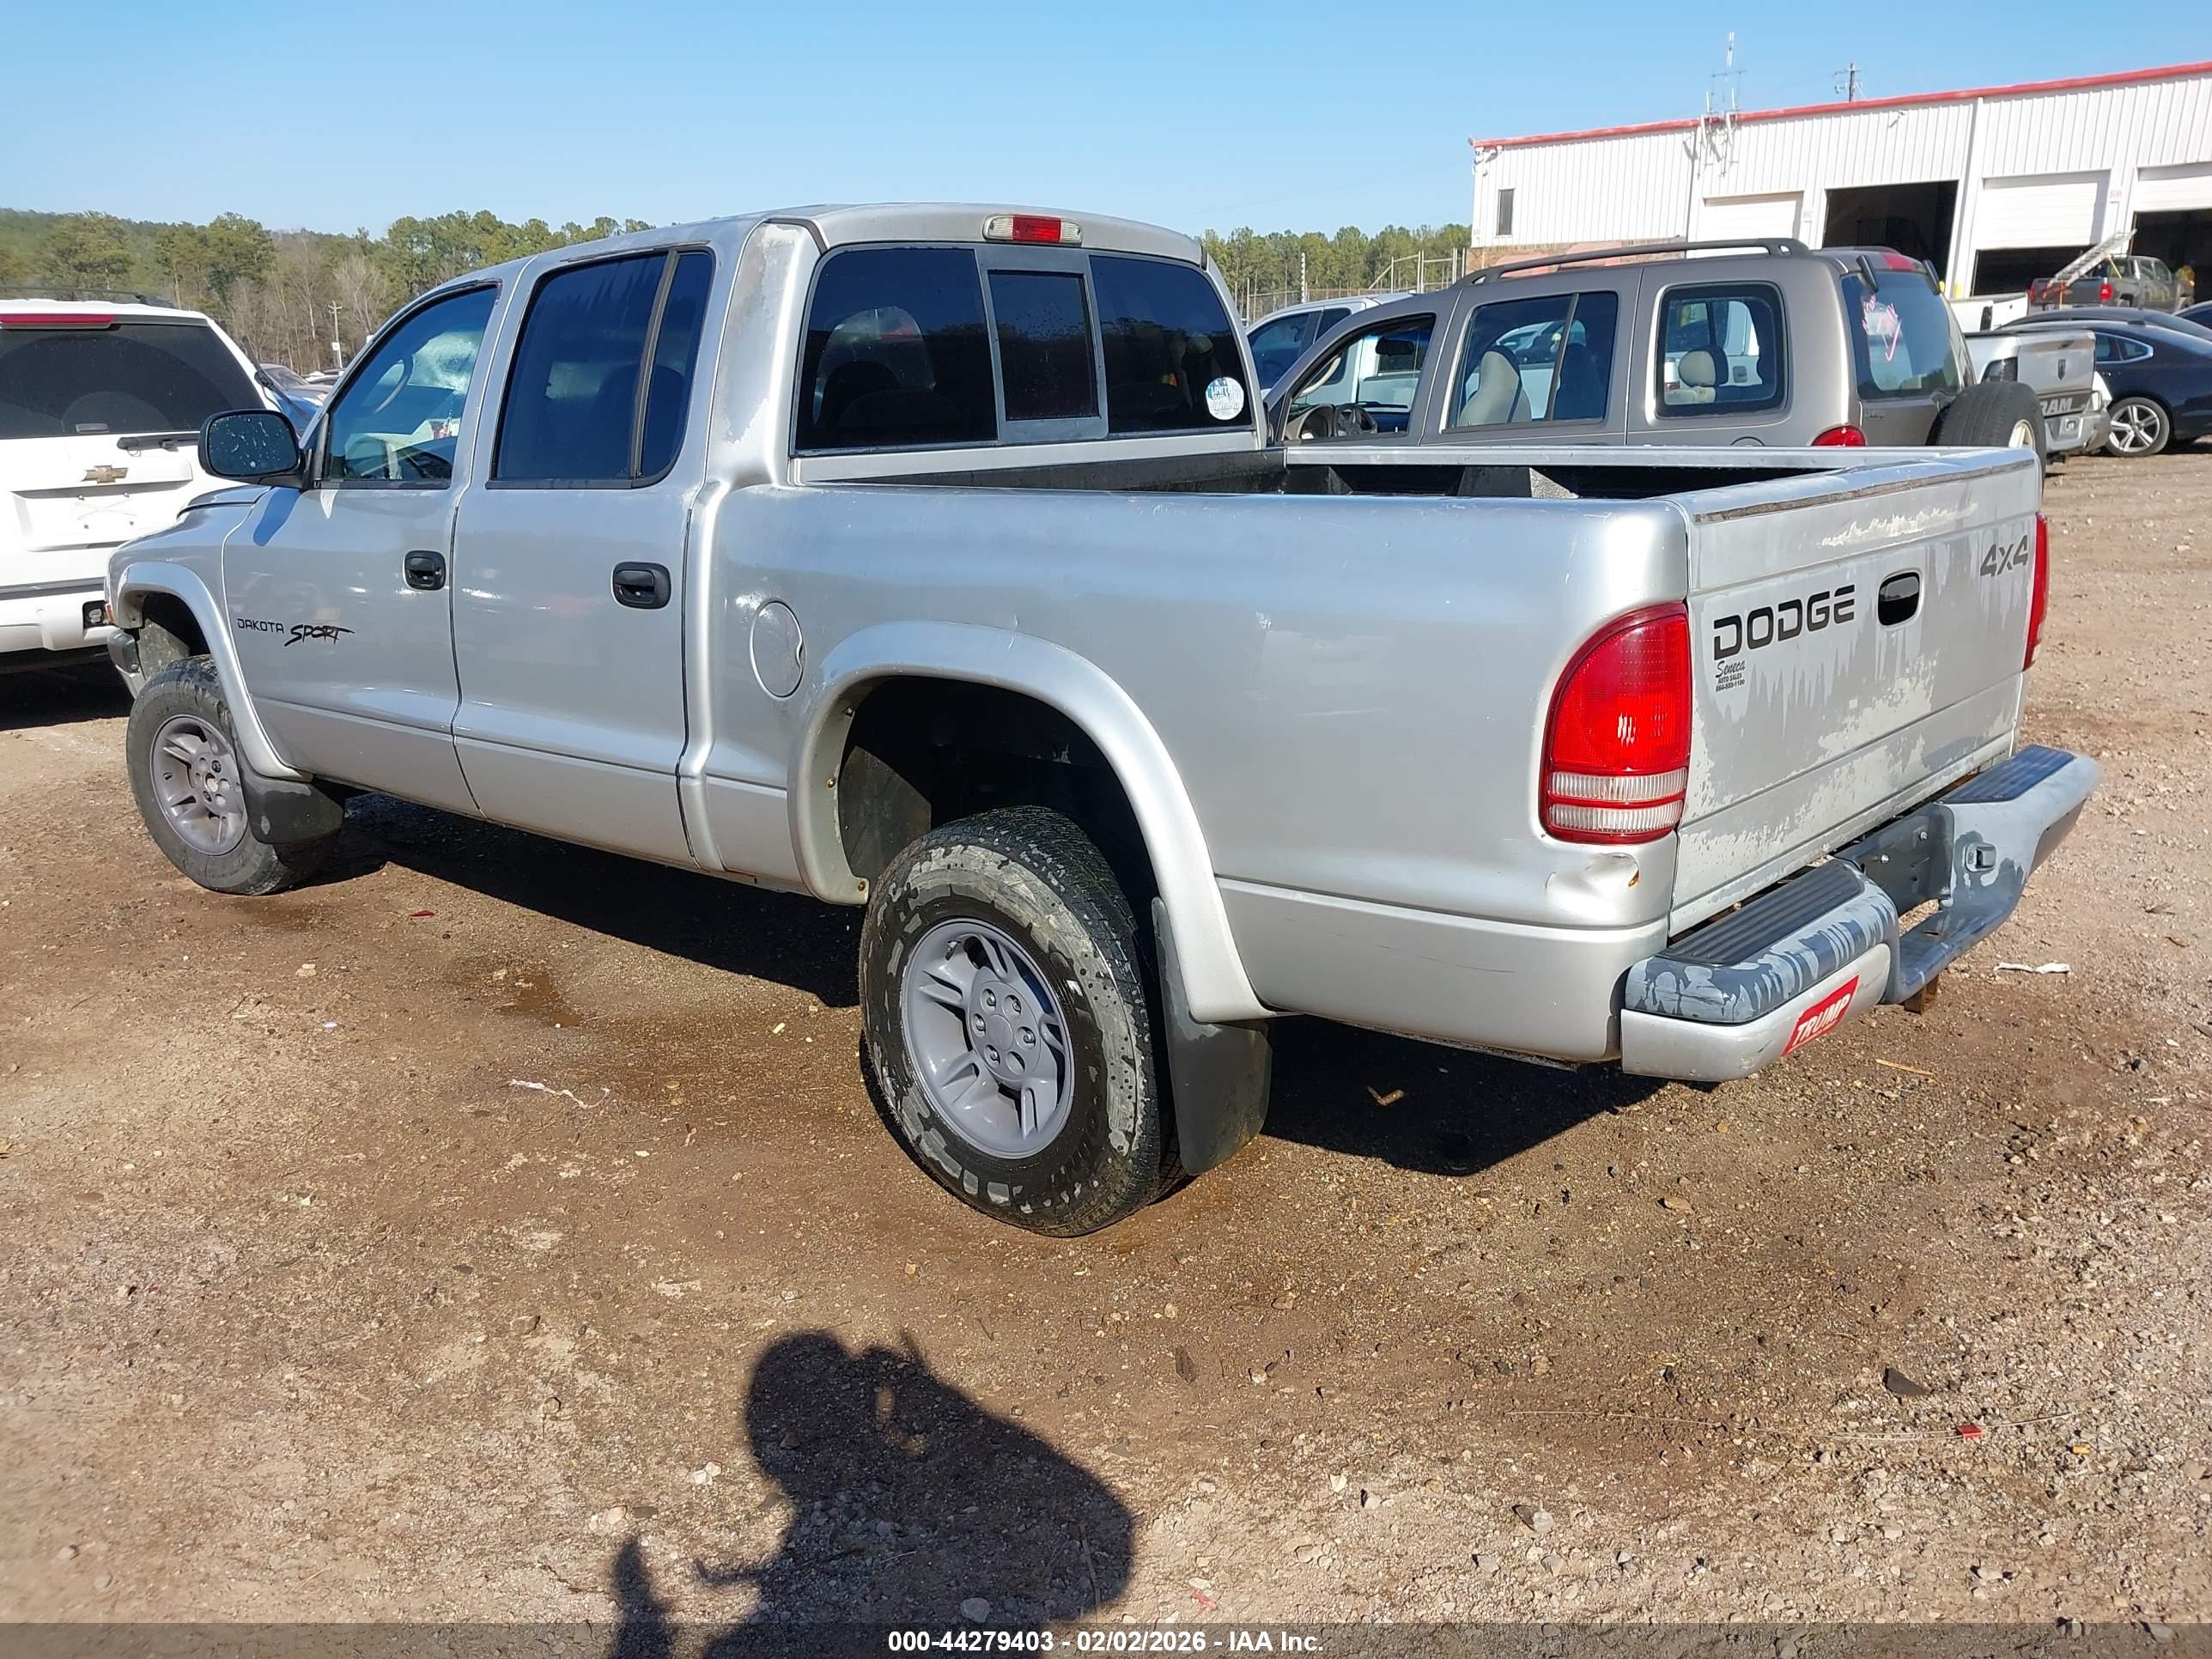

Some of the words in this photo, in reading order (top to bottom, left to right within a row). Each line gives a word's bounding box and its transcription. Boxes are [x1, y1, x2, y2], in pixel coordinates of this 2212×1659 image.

[237, 617, 284, 634] DAKOTA
[284, 623, 356, 647] SPORT
[1713, 584, 1855, 660] DODGE
[1715, 659, 1746, 678] Seneca
[1718, 676, 1729, 684] AUTO
[1729, 672, 1743, 682] SALES
[1791, 993, 1851, 1047] TRUMP
